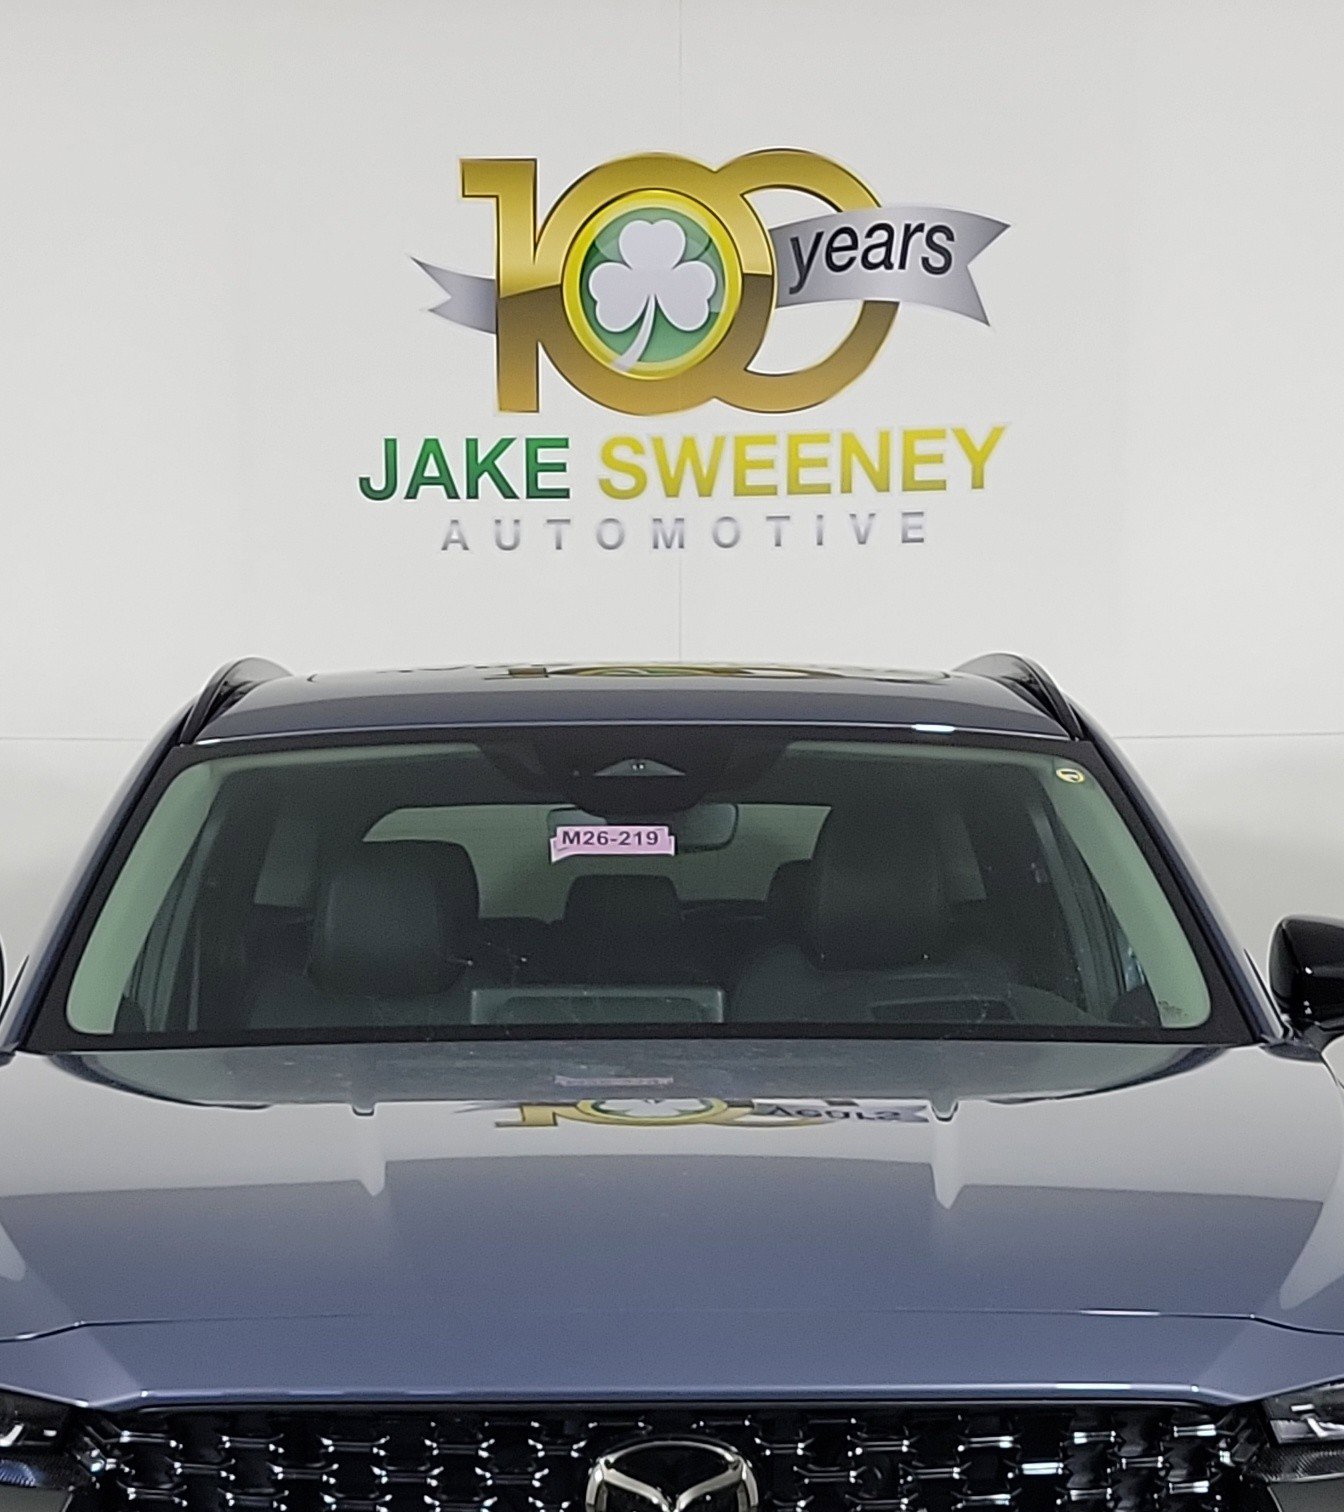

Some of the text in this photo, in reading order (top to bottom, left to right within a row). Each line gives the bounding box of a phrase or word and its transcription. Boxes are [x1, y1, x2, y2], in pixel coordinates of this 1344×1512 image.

[460, 148, 956, 415] 100 years
[358, 425, 1006, 502] JAKE SWEENEY
[441, 511, 926, 552] AUTOMOTIVE
[562, 830, 659, 846] M26-219
